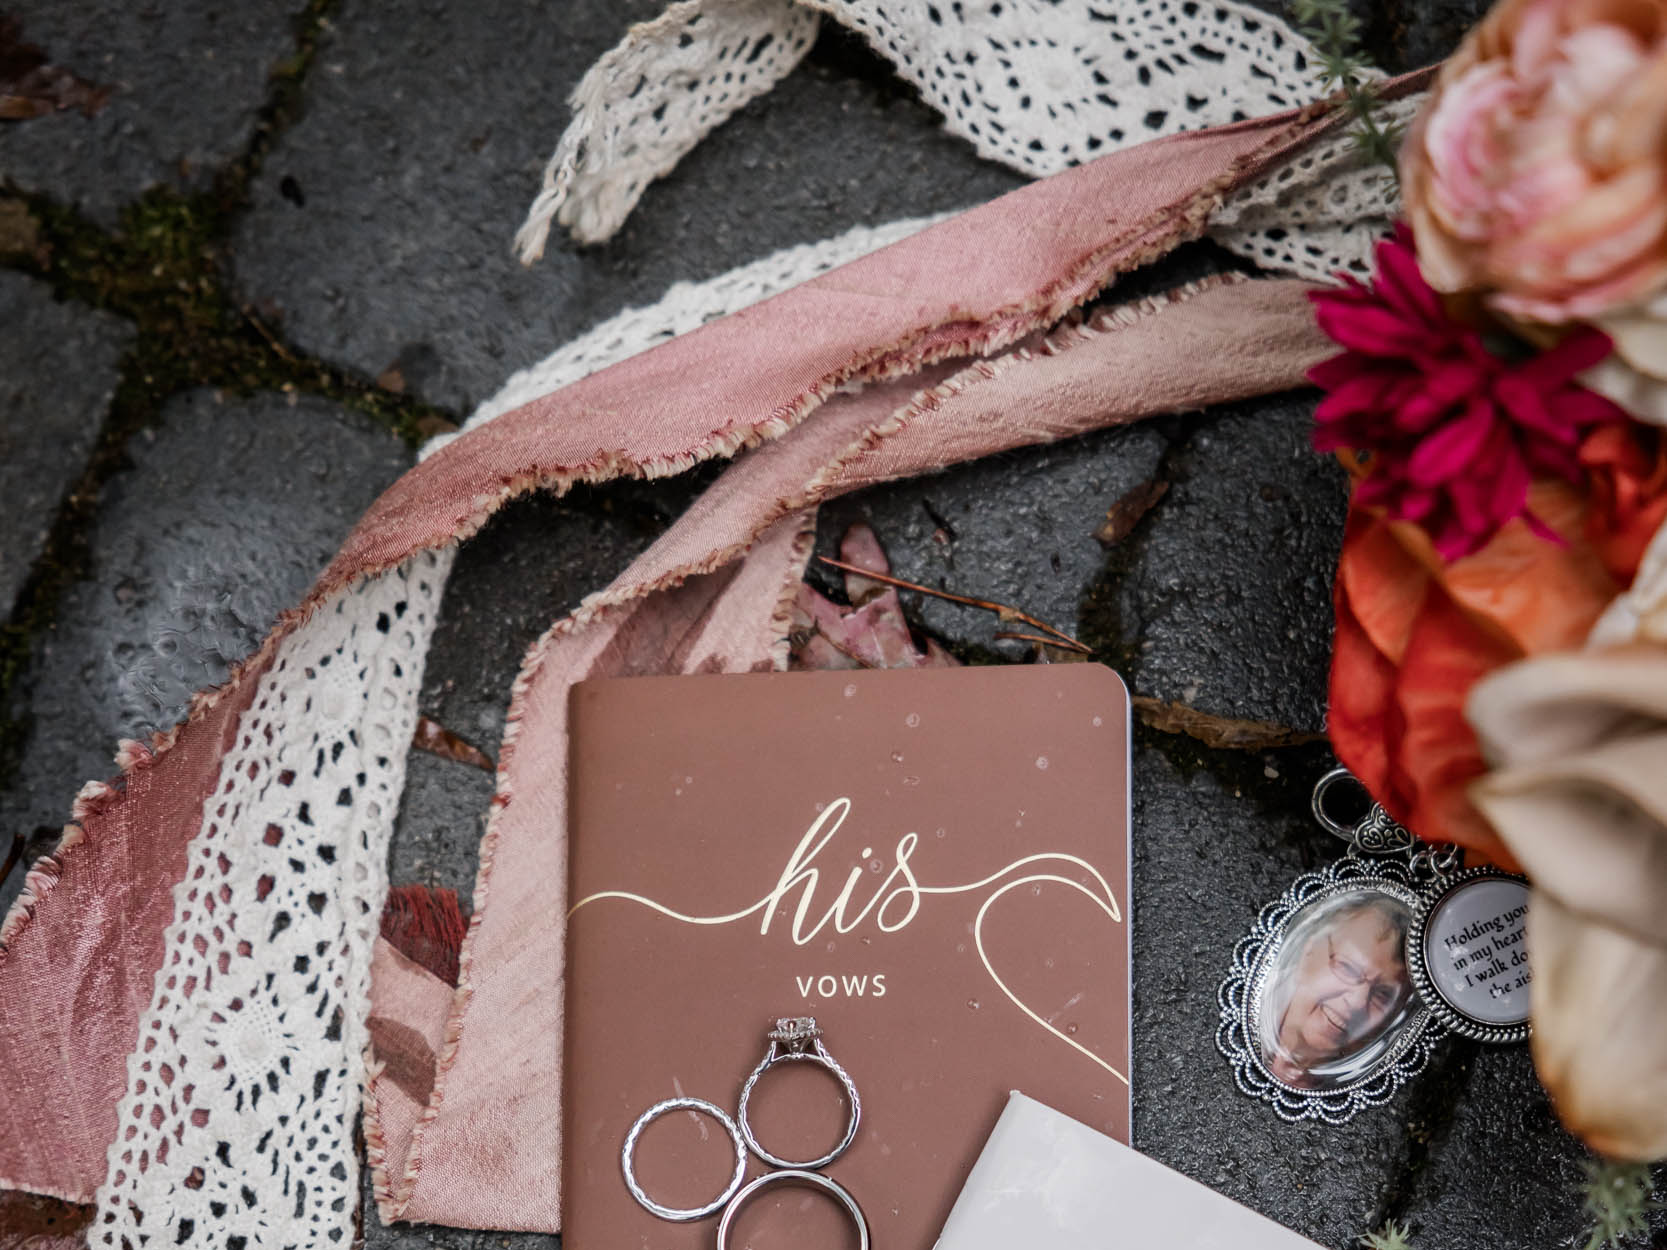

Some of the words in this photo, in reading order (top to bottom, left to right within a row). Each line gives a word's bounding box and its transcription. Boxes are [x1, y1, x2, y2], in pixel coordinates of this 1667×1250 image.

[760, 797, 921, 946] his
[1444, 917, 1504, 948] Holding
[1453, 957, 1468, 971] in
[1470, 946, 1493, 963] my
[796, 974, 887, 998] VOWS
[1464, 974, 1474, 988] I
[1475, 958, 1509, 984] walk
[1489, 980, 1513, 999] the
